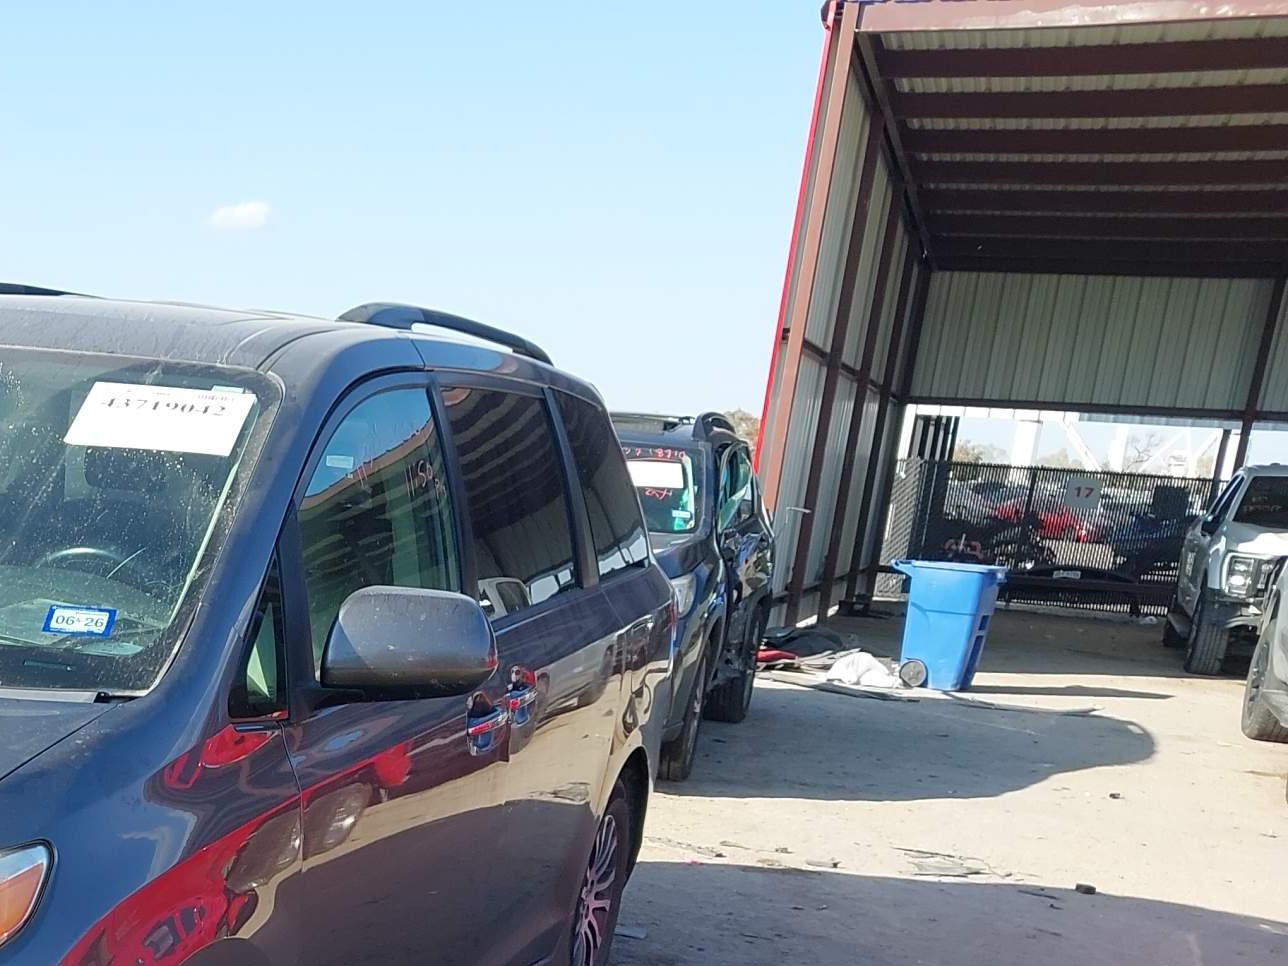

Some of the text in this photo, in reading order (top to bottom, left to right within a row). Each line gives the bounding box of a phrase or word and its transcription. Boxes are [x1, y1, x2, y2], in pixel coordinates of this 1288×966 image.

[101, 397, 226, 417] 43719042
[1074, 486, 1095, 498] 17
[55, 614, 105, 628] 06 26
